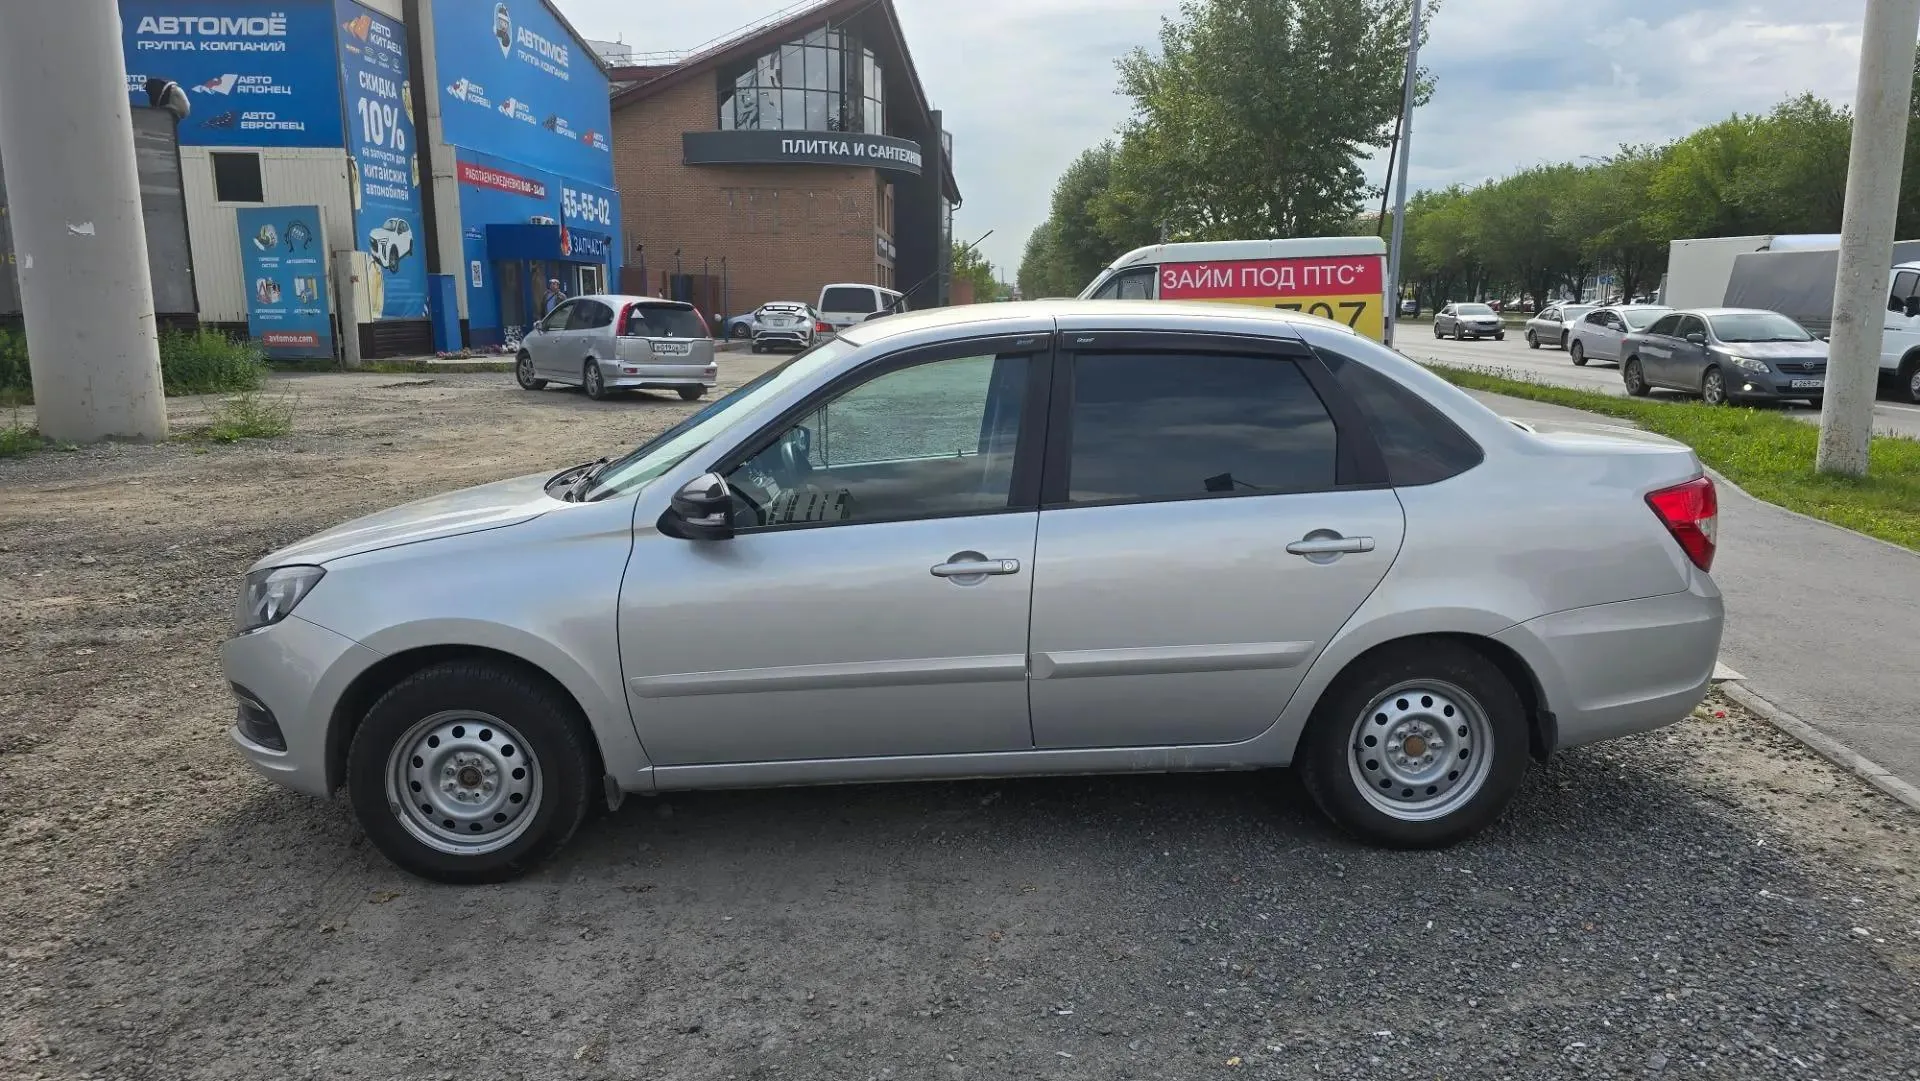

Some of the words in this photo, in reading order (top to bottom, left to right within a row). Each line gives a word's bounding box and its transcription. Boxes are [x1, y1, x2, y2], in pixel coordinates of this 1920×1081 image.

[136, 12, 287, 36] АВТОМОЁ
[137, 41, 196, 50] ГРУППА
[200, 41, 286, 51] КОМПАНИЙ
[517, 26, 569, 68] АВТОМОЁ
[237, 85, 292, 95] ЯПОНЕЦ
[238, 76, 272, 84] АВТО
[359, 70, 398, 99] СКИДКА
[240, 121, 305, 131] ЕВРОПЕЕЦ
[242, 112, 276, 120] АВТО
[358, 97, 406, 151] 10%
[781, 139, 851, 156] ПЛИТКА
[853, 142, 865, 157] И
[562, 187, 611, 226] 55-55-02
[1163, 265, 1233, 289] ЗАЙМ
[1241, 267, 1296, 290] ПОД
